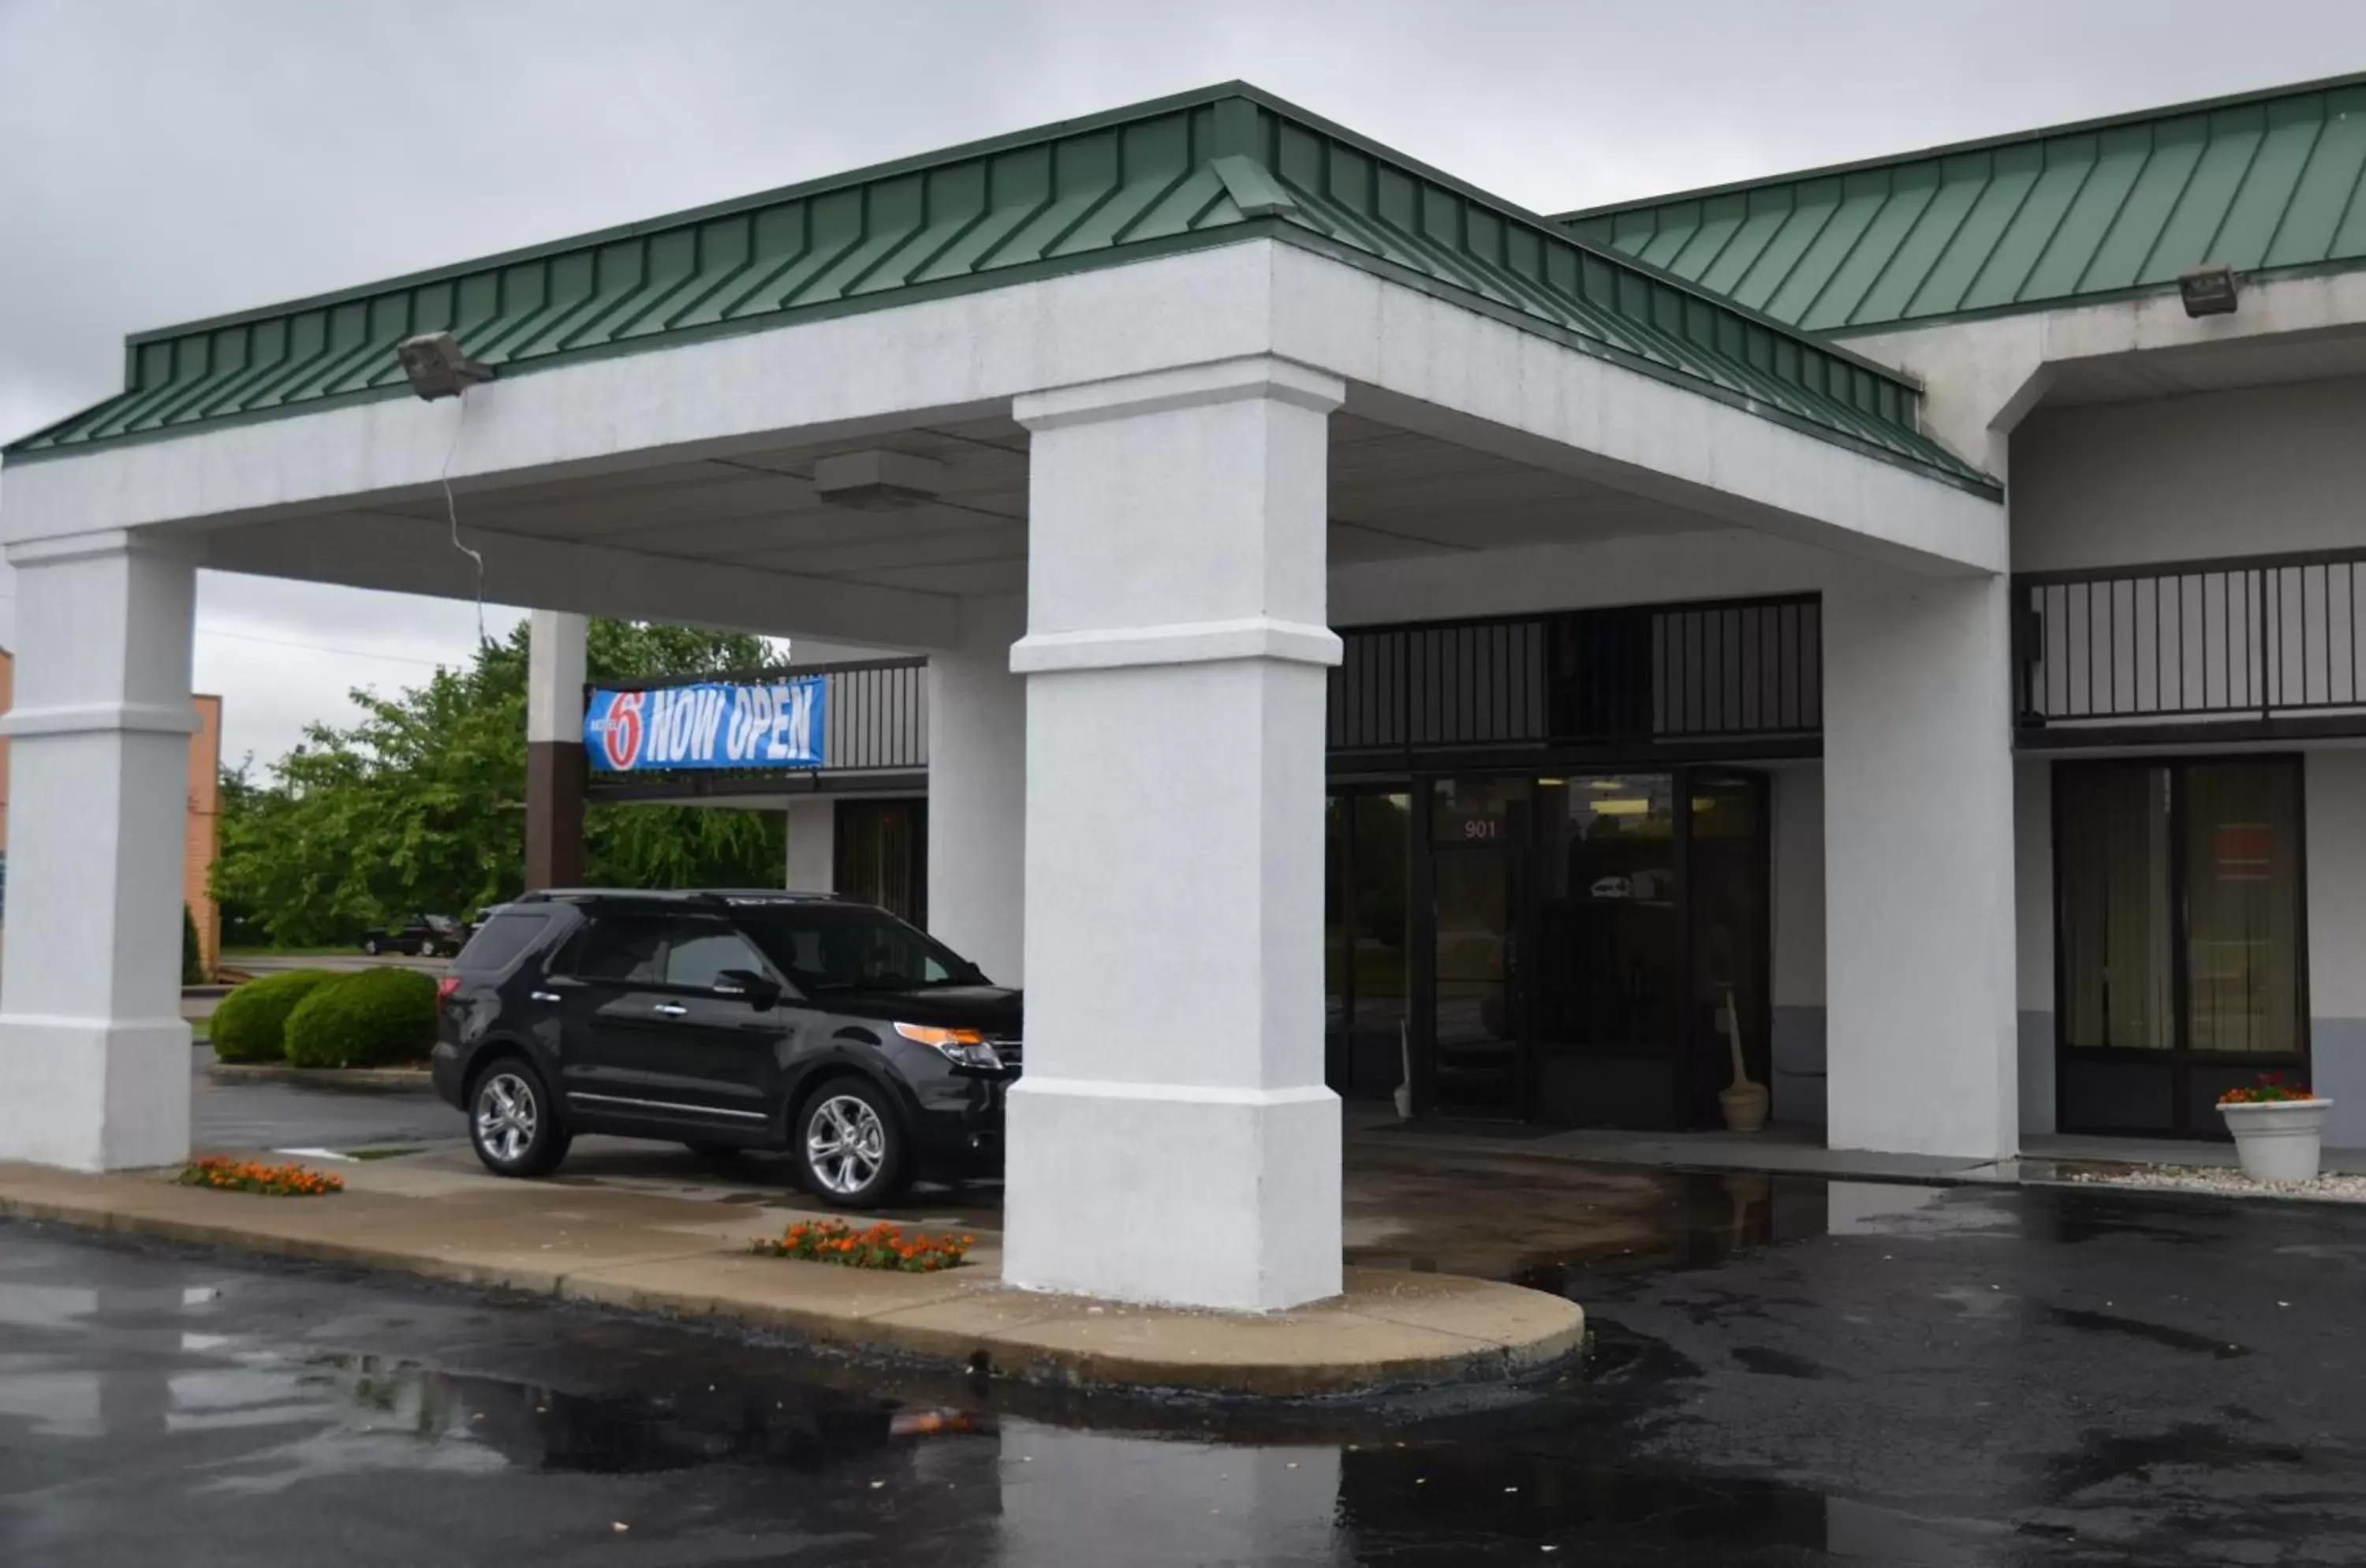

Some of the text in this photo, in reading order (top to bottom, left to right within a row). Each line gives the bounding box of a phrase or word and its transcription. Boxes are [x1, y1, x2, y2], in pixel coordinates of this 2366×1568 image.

[603, 685, 813, 771] 6 NOW OPEN
[1465, 819, 1495, 838] 901
